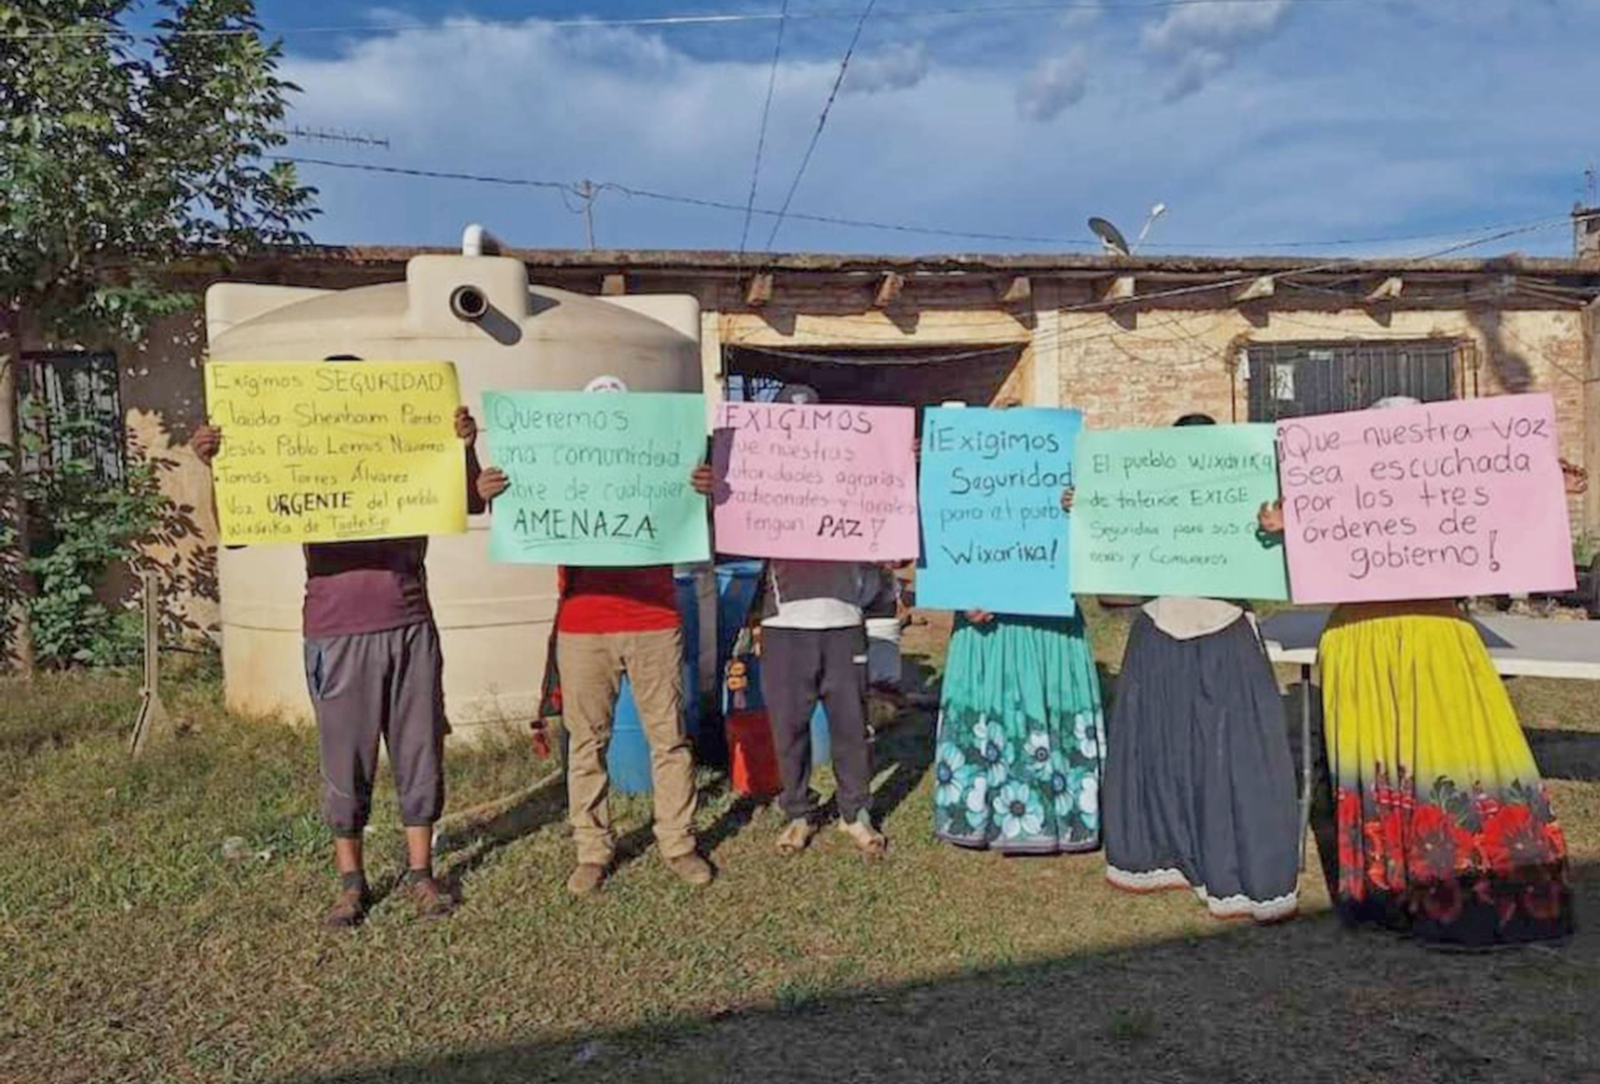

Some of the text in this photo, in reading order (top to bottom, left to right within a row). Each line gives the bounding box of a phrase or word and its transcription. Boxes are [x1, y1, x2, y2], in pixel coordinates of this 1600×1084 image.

[212, 366, 443, 397] Exigimos SEGURIDAD
[494, 396, 630, 434] Queremos
[725, 405, 873, 440] EXIGIMOS
[1363, 411, 1472, 448] nuestra
[552, 439, 681, 467] comunidad
[769, 440, 856, 462] nuestras
[1092, 454, 1110, 474] El
[1123, 449, 1177, 480] pueblo
[1287, 444, 1532, 487] sea escuchada
[283, 464, 338, 485] Torres
[564, 477, 590, 501] de
[731, 459, 906, 496] utoridades agrarias
[949, 460, 1074, 498] Seguridad
[266, 492, 353, 517] URGENTE
[366, 491, 389, 511] del
[1089, 489, 1111, 508] de
[1190, 487, 1250, 507] EXIGE
[1294, 481, 1492, 524] por los tres
[303, 515, 320, 534] de
[513, 507, 659, 540] AMENAZA
[940, 508, 983, 532] para
[1439, 509, 1478, 535] de
